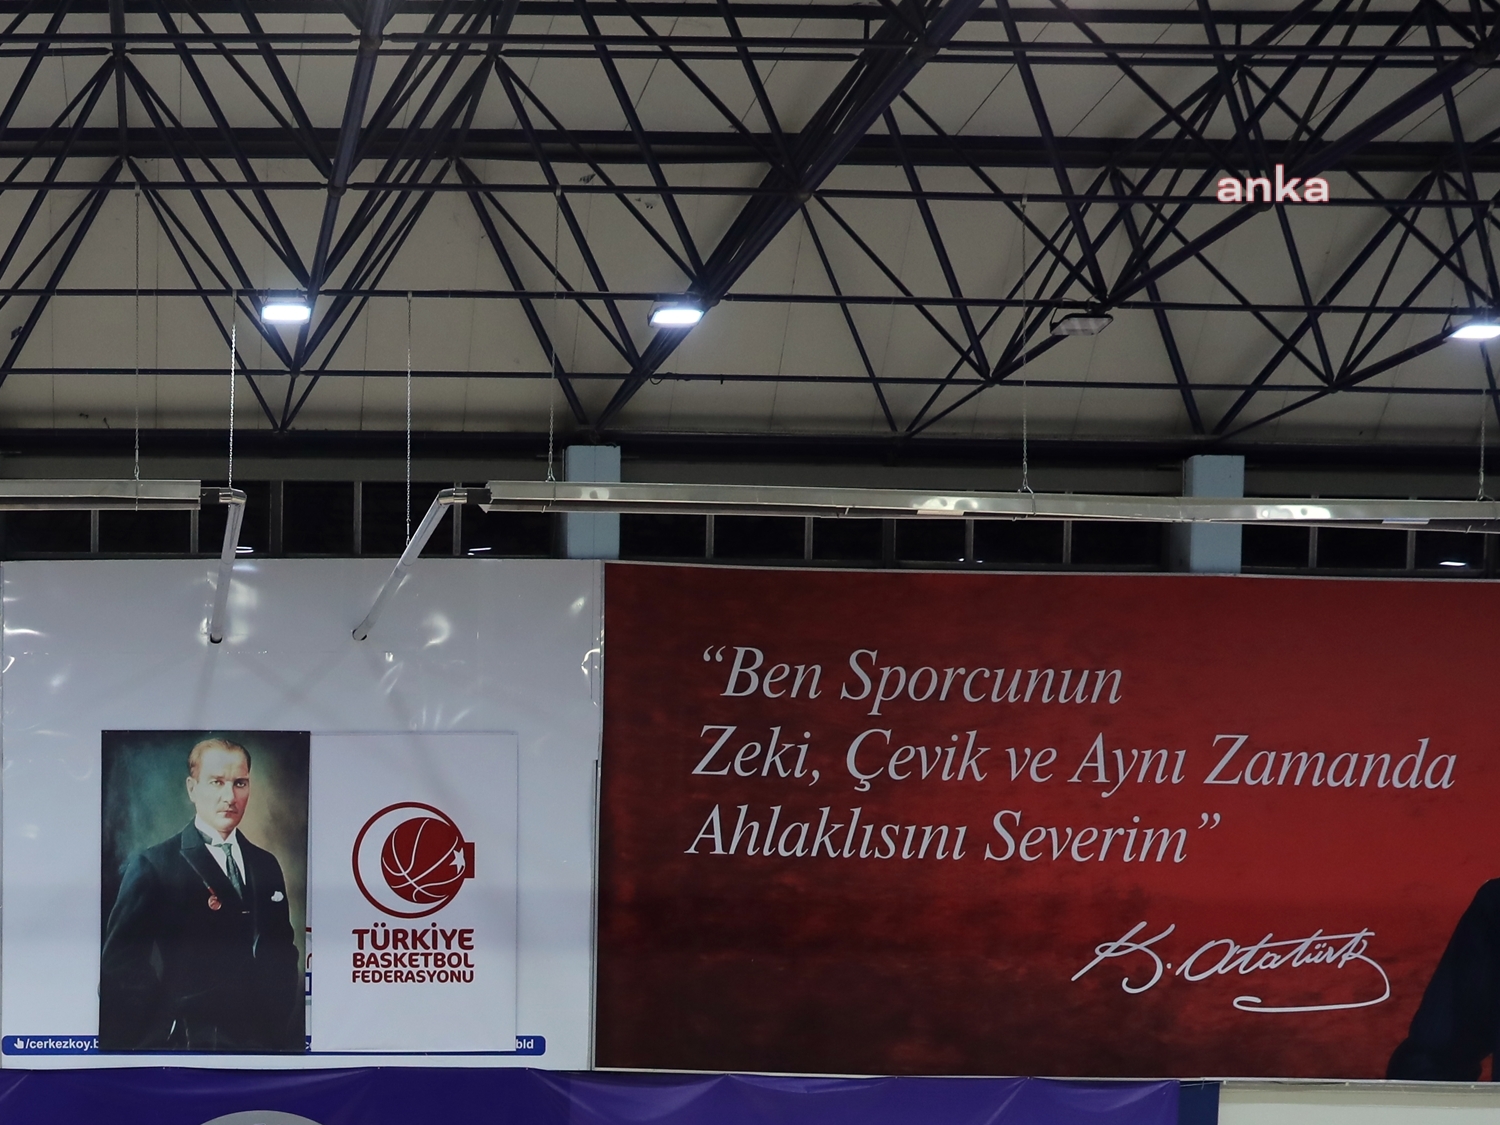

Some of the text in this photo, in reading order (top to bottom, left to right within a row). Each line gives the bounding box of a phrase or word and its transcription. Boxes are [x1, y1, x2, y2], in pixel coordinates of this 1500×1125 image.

[701, 645, 1123, 714] “Ben Sporcunun
[692, 724, 1457, 797] Zeki, Çevik ve Aynı Zamanda
[684, 804, 1222, 864] Ahlaklısını Severim”
[352, 922, 475, 950] TÜRKİYE
[352, 952, 475, 968] BASKETBOL
[352, 970, 475, 983] FEDERASYONU
